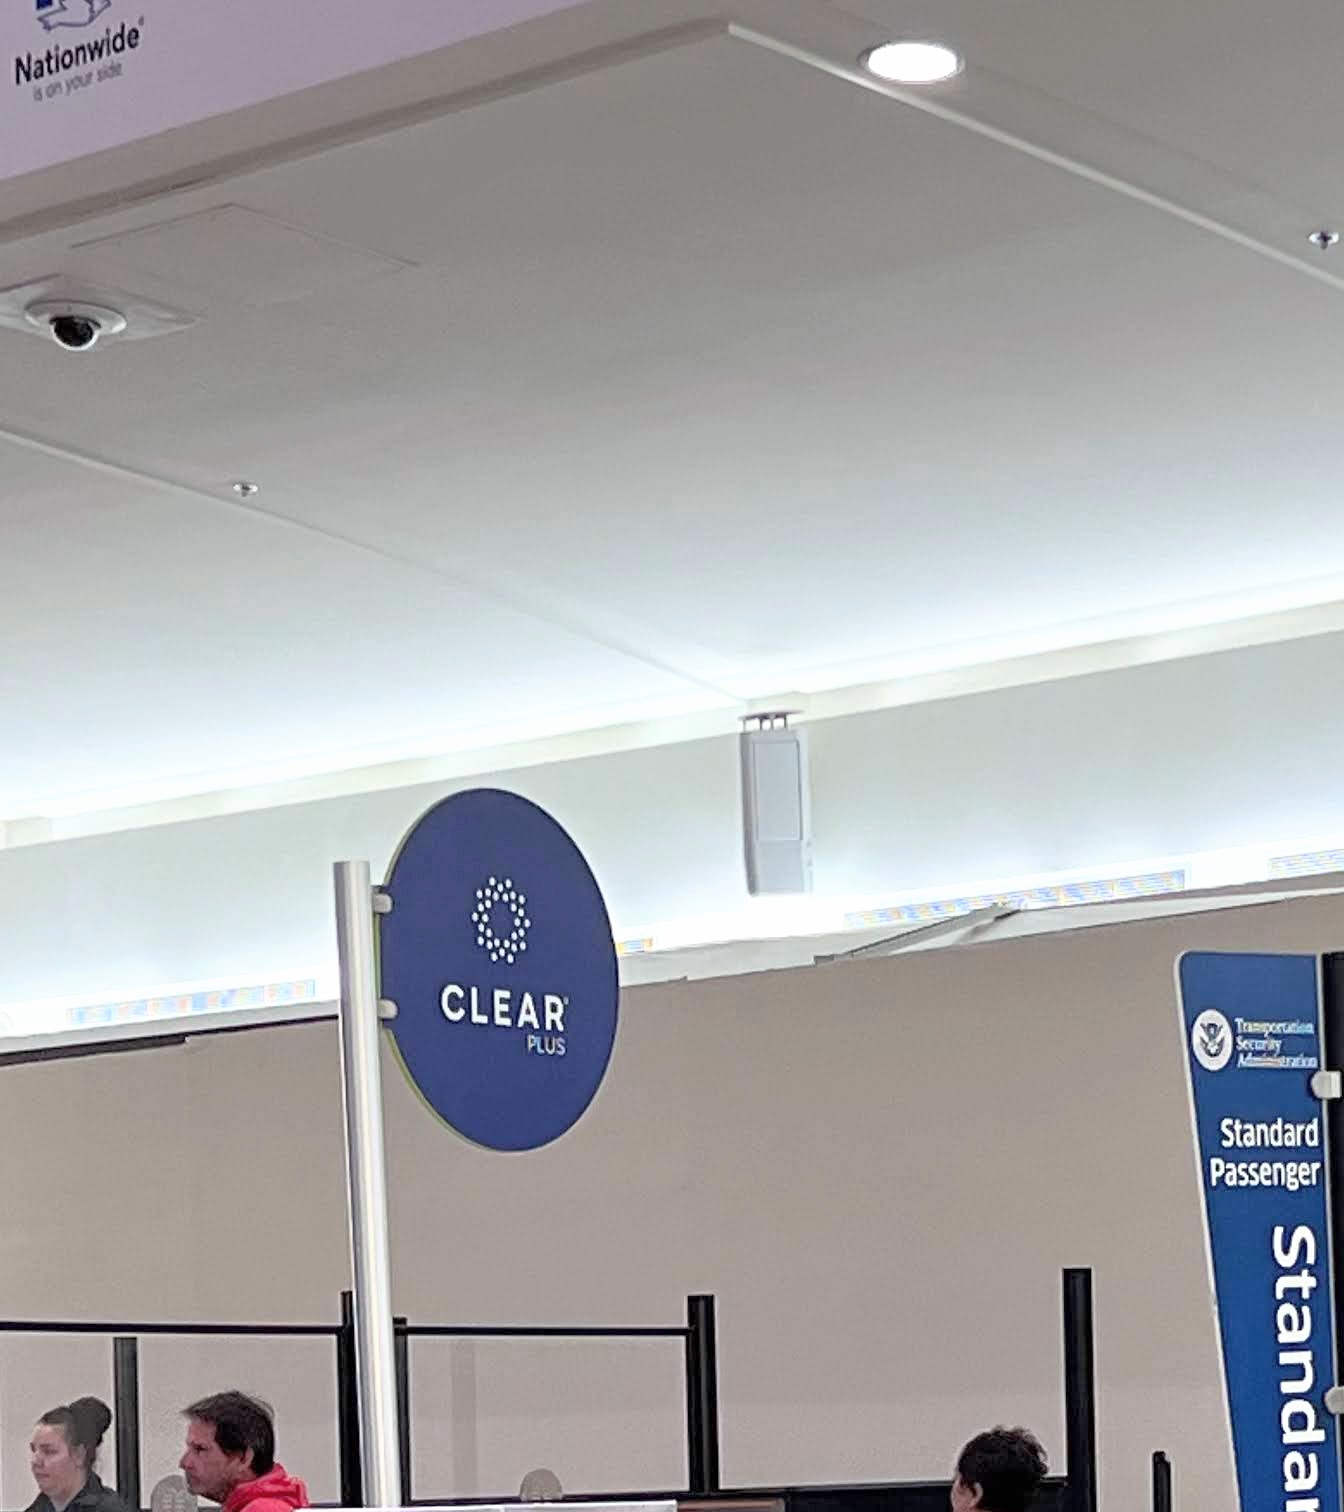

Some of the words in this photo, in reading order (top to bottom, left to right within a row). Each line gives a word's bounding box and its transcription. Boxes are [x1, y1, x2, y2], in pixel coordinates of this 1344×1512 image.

[15, 22, 141, 87] Nationwide
[441, 984, 565, 1032] CLEAR
[1235, 1017, 1315, 1038] Transportation
[527, 1035, 567, 1057] PLUS
[1236, 1035, 1282, 1055] Security
[1221, 1117, 1319, 1148] Standard
[1210, 1157, 1321, 1191] Passenger
